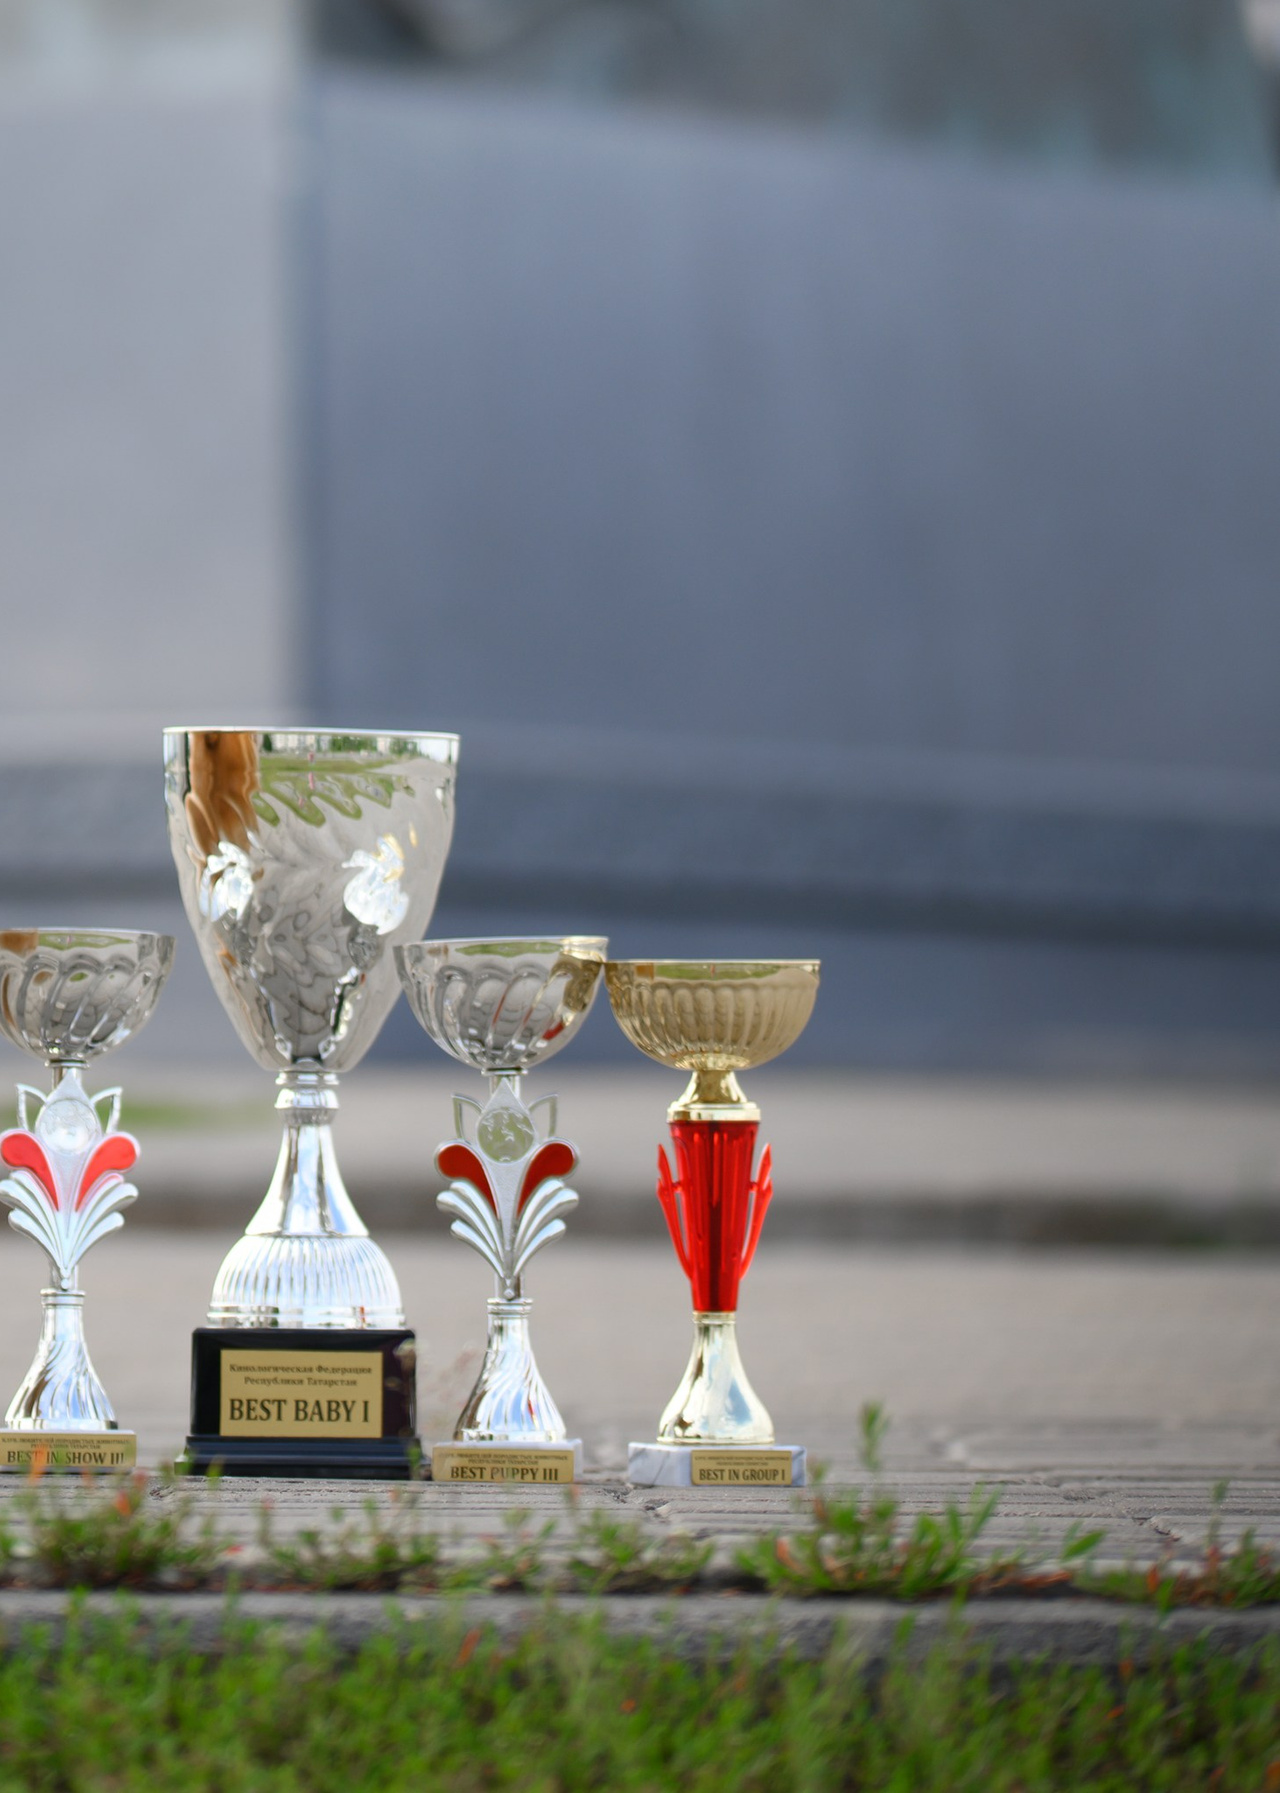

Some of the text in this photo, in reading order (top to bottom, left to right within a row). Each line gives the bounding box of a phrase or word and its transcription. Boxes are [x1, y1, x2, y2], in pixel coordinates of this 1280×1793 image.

[229, 1364, 373, 1376] Кинологическая Федерация
[244, 1376, 358, 1387] Республики Татарстан
[229, 1398, 370, 1423] BEST BABY I
[65, 1451, 107, 1465] SHOW
[110, 1452, 125, 1465] III
[450, 1466, 558, 1481] BEST PUPPY III
[699, 1468, 725, 1481] BEST
[728, 1469, 739, 1481] IN
[742, 1469, 779, 1481] GROUP
